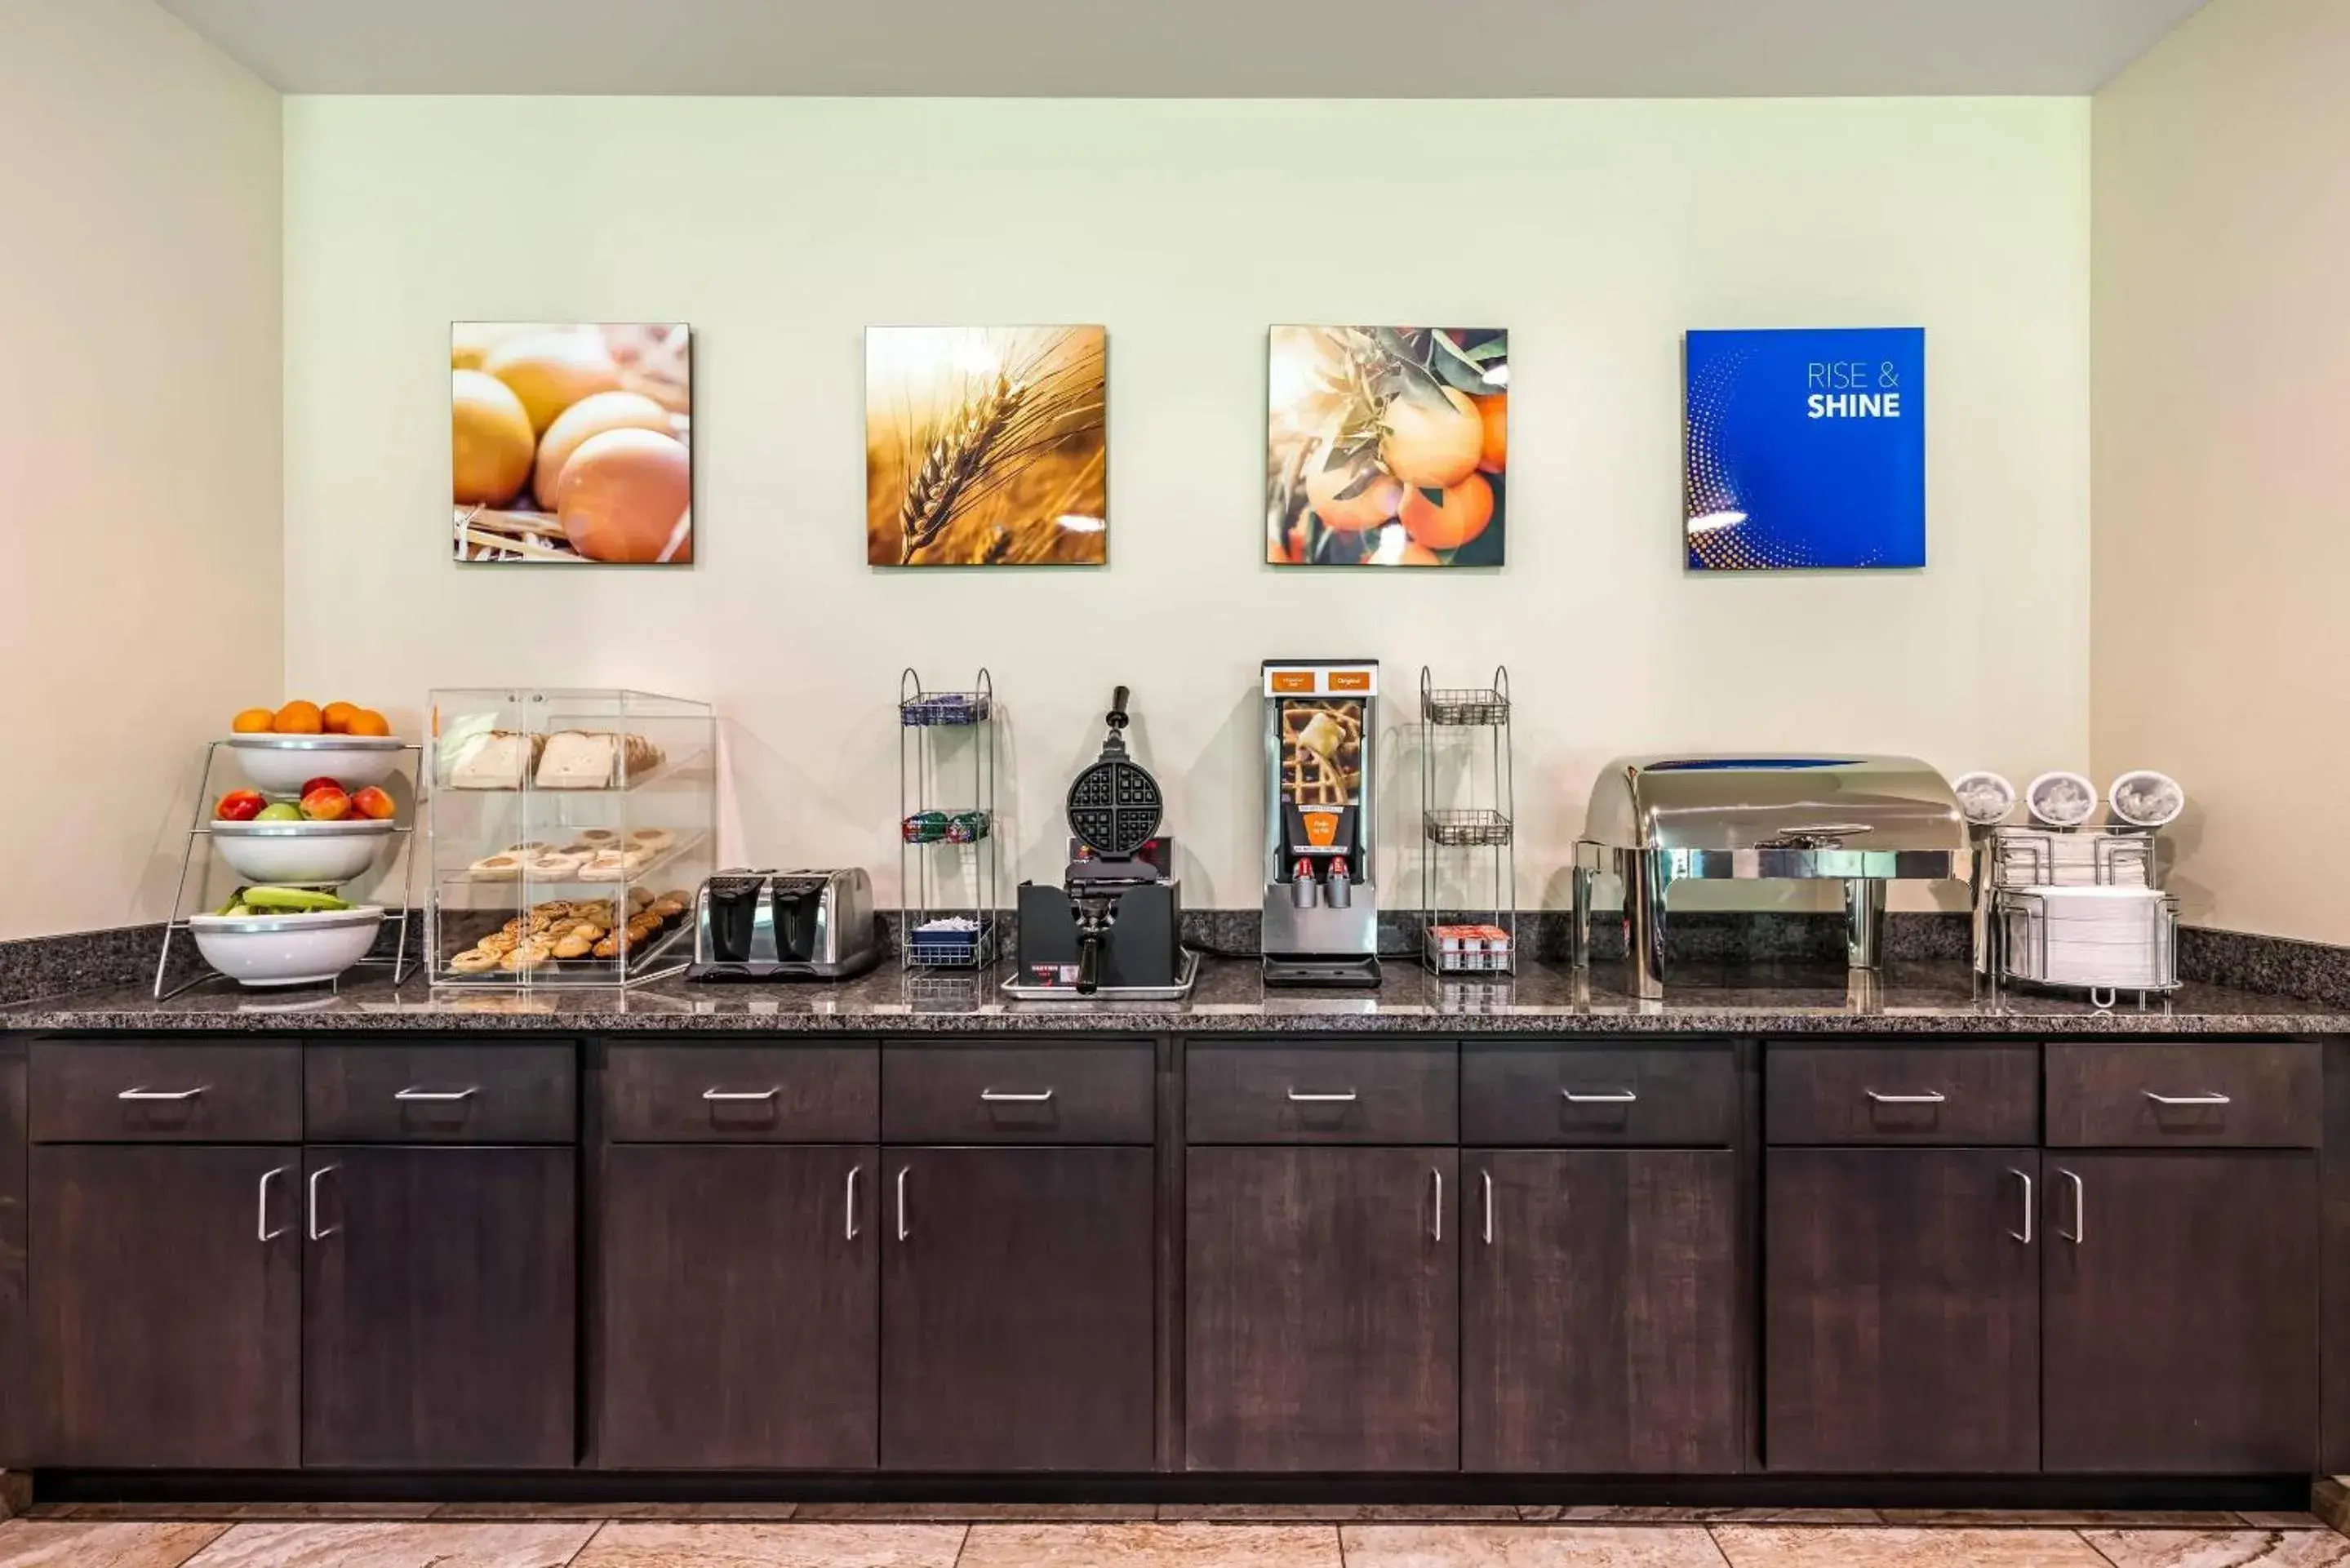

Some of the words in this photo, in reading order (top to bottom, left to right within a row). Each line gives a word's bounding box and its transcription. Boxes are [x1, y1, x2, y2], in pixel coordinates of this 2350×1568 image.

[1808, 361, 1868, 389] RISE
[1878, 361, 1899, 388] &
[1807, 393, 1900, 419] SHINE
